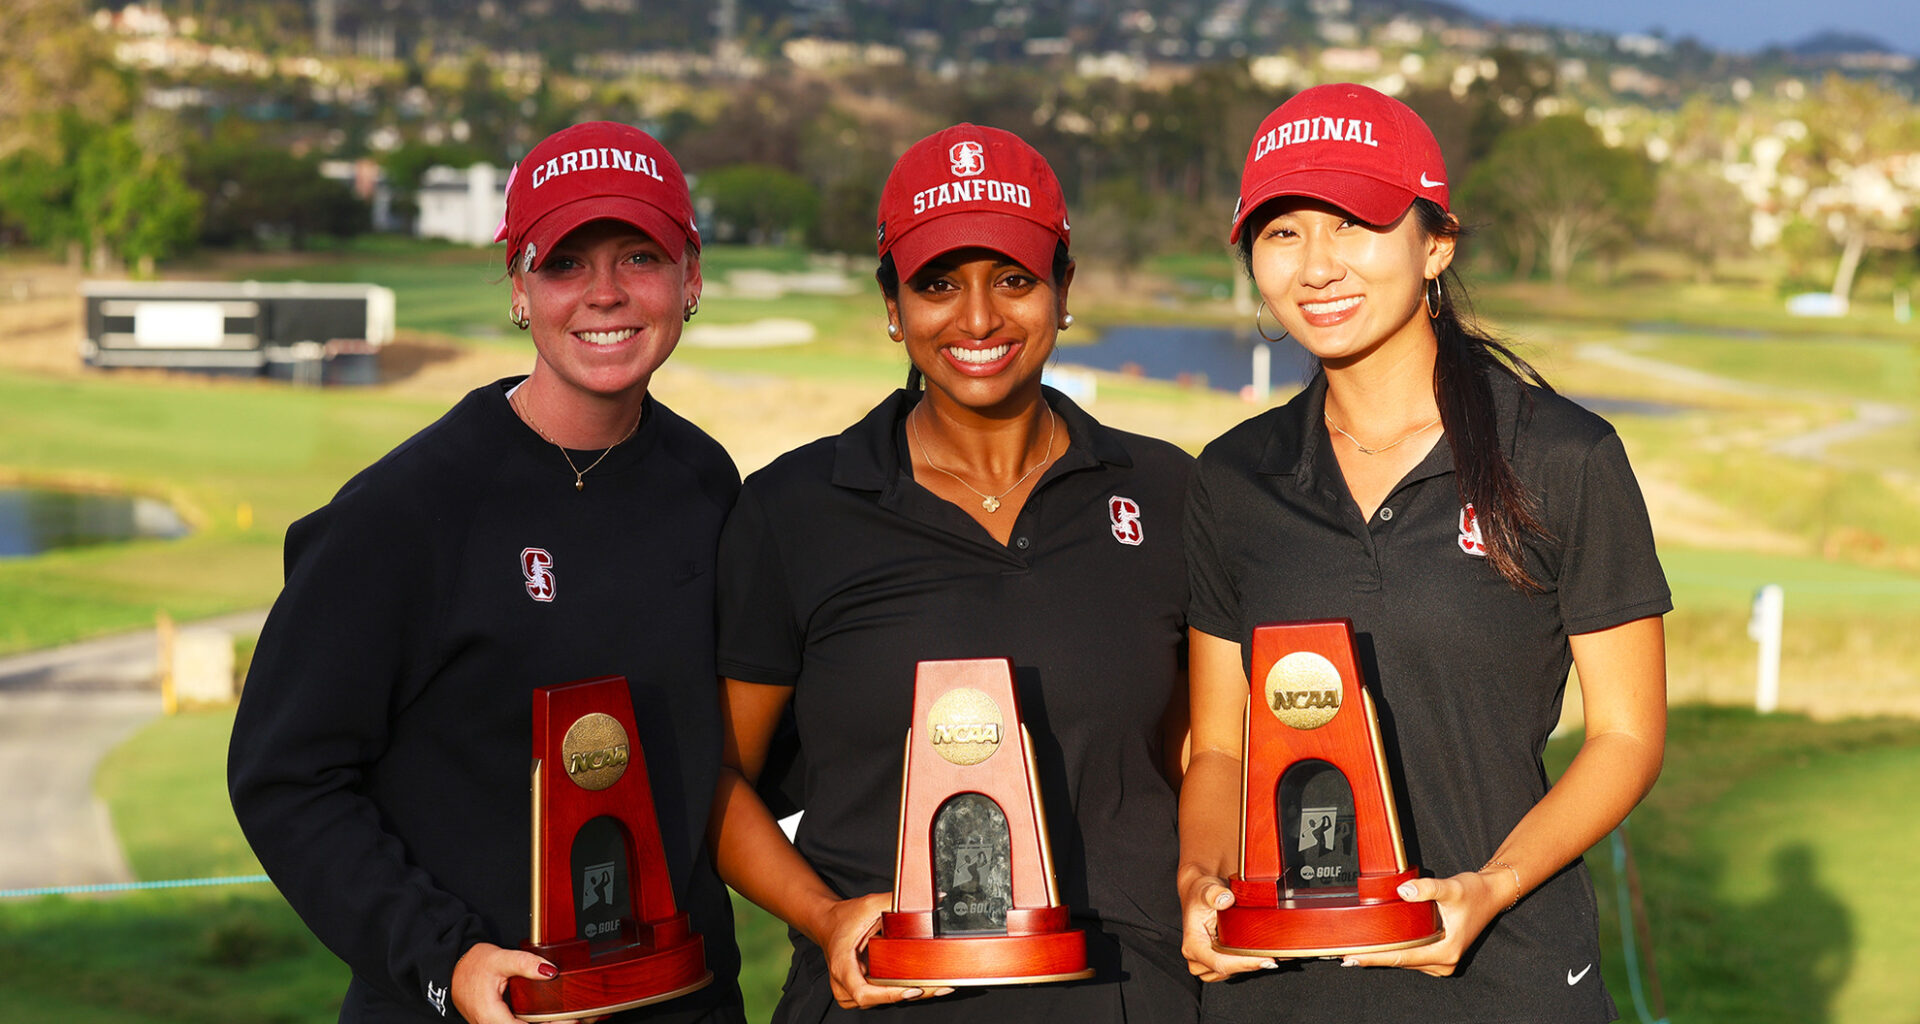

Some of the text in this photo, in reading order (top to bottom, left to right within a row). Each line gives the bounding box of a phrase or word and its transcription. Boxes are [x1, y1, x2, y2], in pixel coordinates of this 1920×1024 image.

[1255, 116, 1378, 162] CARDINAL
[532, 148, 664, 189] CARDINAL
[913, 180, 1031, 215] STANFORD
[1273, 687, 1339, 711] NCAA
[933, 723, 999, 745] NCAA
[570, 743, 627, 774] NCAA
[1316, 866, 1342, 878] GOLF
[598, 919, 620, 934] GOLF
